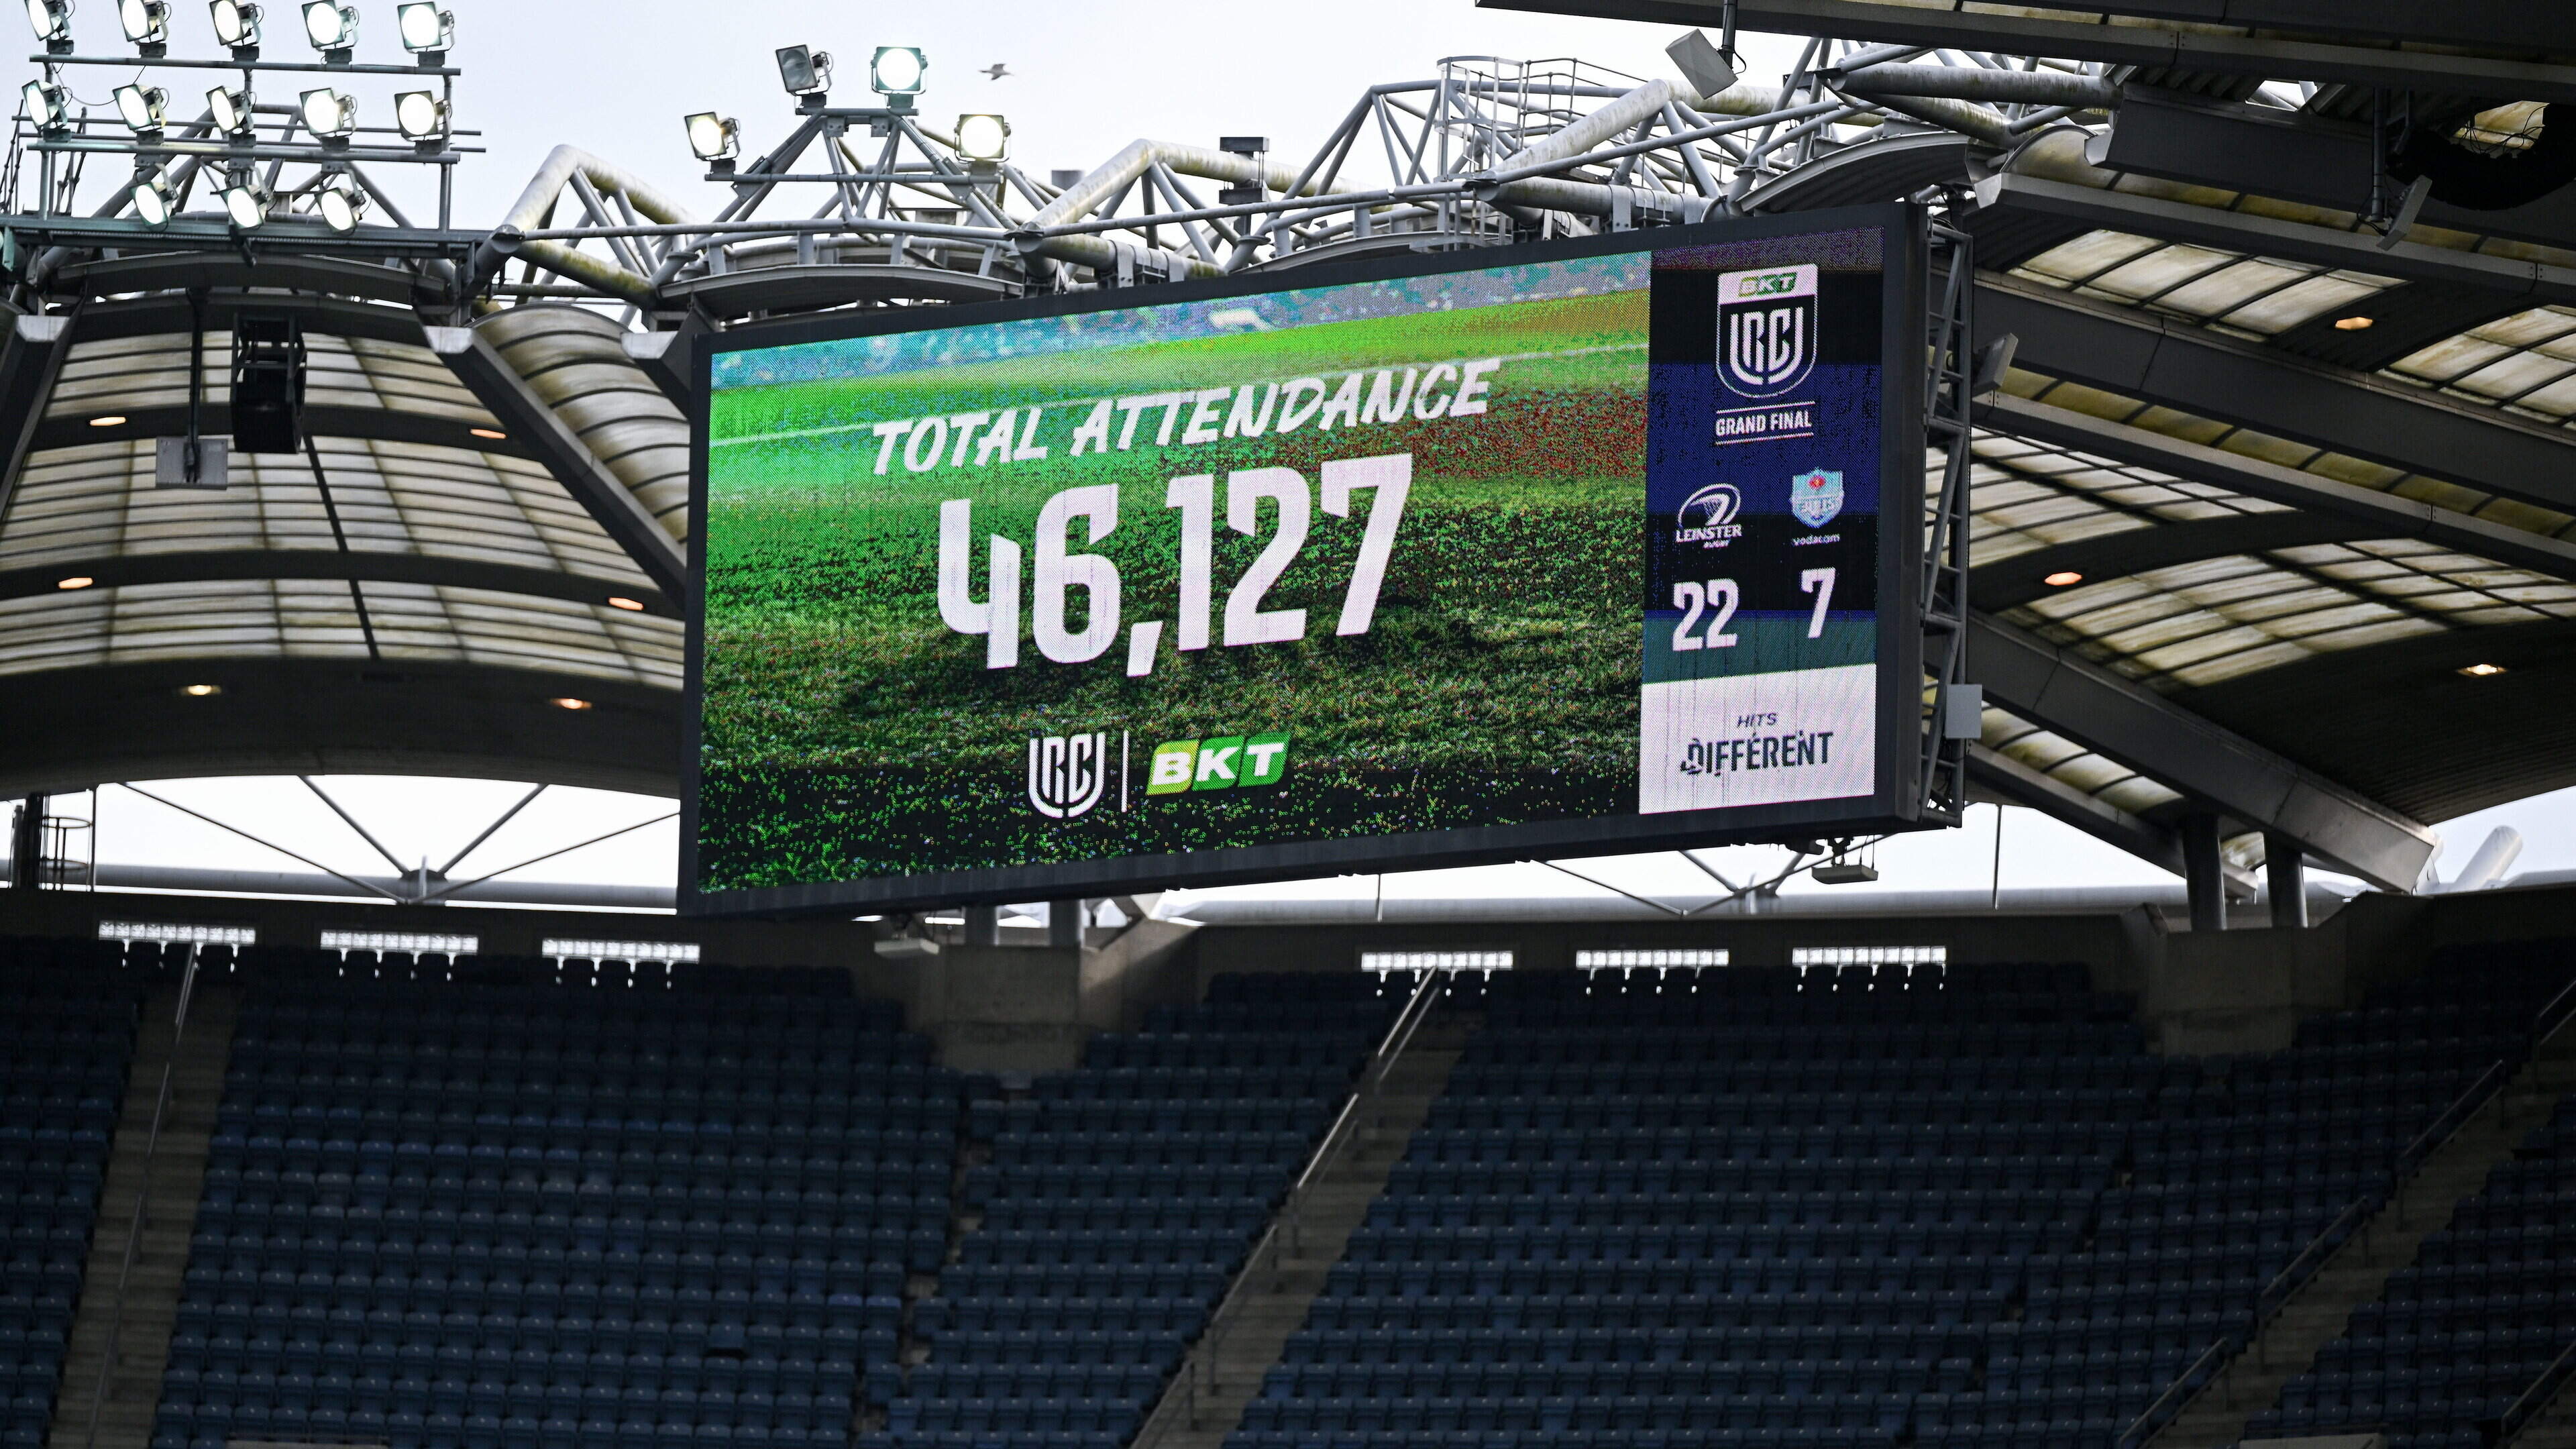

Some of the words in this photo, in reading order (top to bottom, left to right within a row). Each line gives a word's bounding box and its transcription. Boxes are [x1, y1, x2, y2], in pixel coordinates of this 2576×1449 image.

[1741, 276, 1794, 294] BKT
[873, 406, 1050, 476] TOTAL
[1069, 358, 1501, 457] ATTENDANCE
[1715, 414, 1766, 437] GRAND
[1770, 409, 1812, 431] FINAL
[1676, 525, 1742, 543] LEINSTER
[937, 453, 1413, 677] 46,127
[1672, 578, 1739, 651] 22
[1801, 567, 1836, 638] 7
[1737, 712, 1778, 729] HITS
[1151, 742, 1285, 786] BKT
